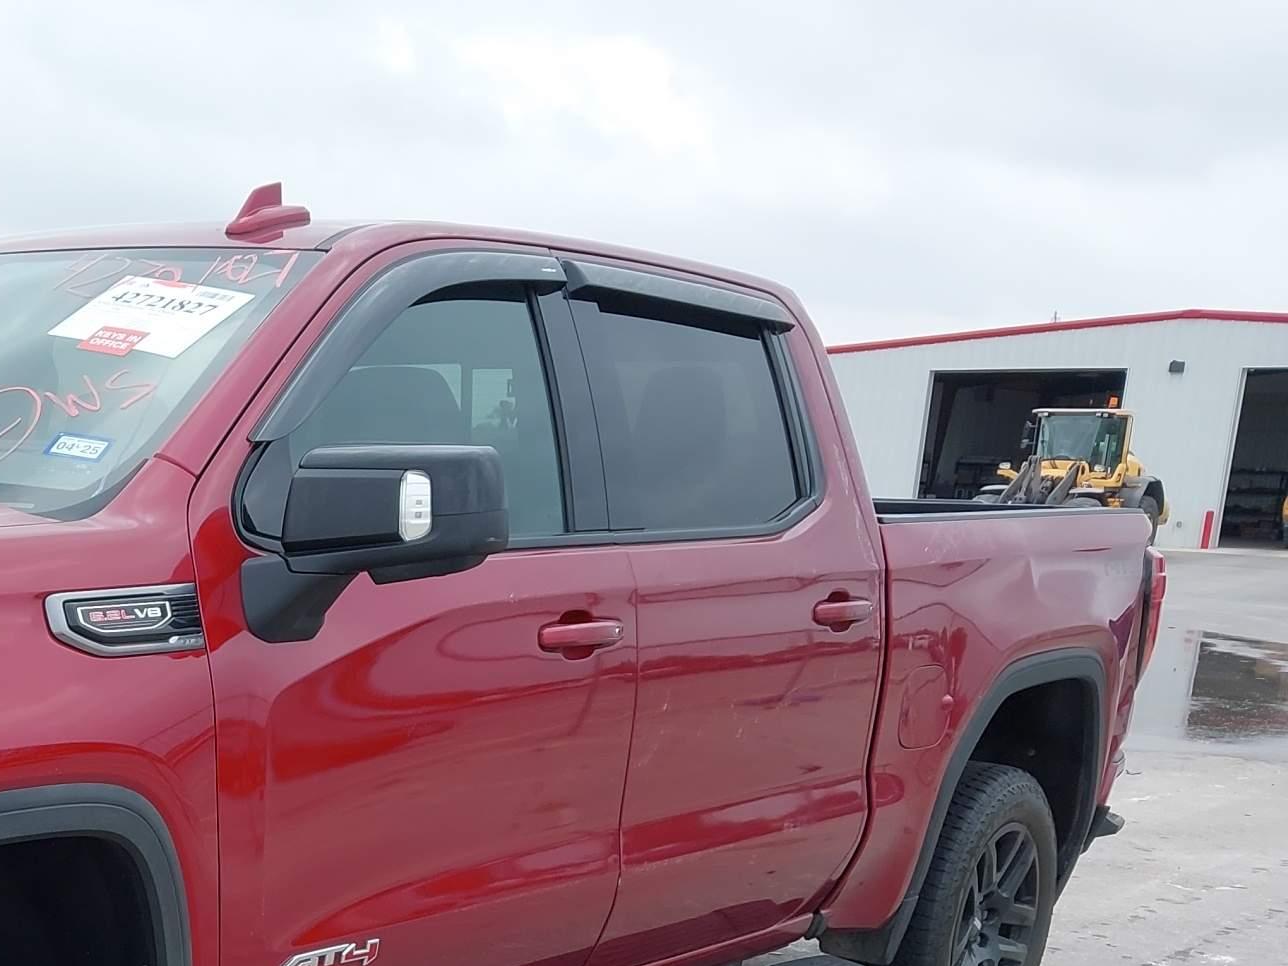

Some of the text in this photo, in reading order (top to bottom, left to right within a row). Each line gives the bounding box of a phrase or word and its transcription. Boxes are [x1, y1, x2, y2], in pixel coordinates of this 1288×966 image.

[112, 290, 217, 316] 42721827
[94, 330, 142, 343] KEYS IN
[89, 338, 131, 350] OFFICE
